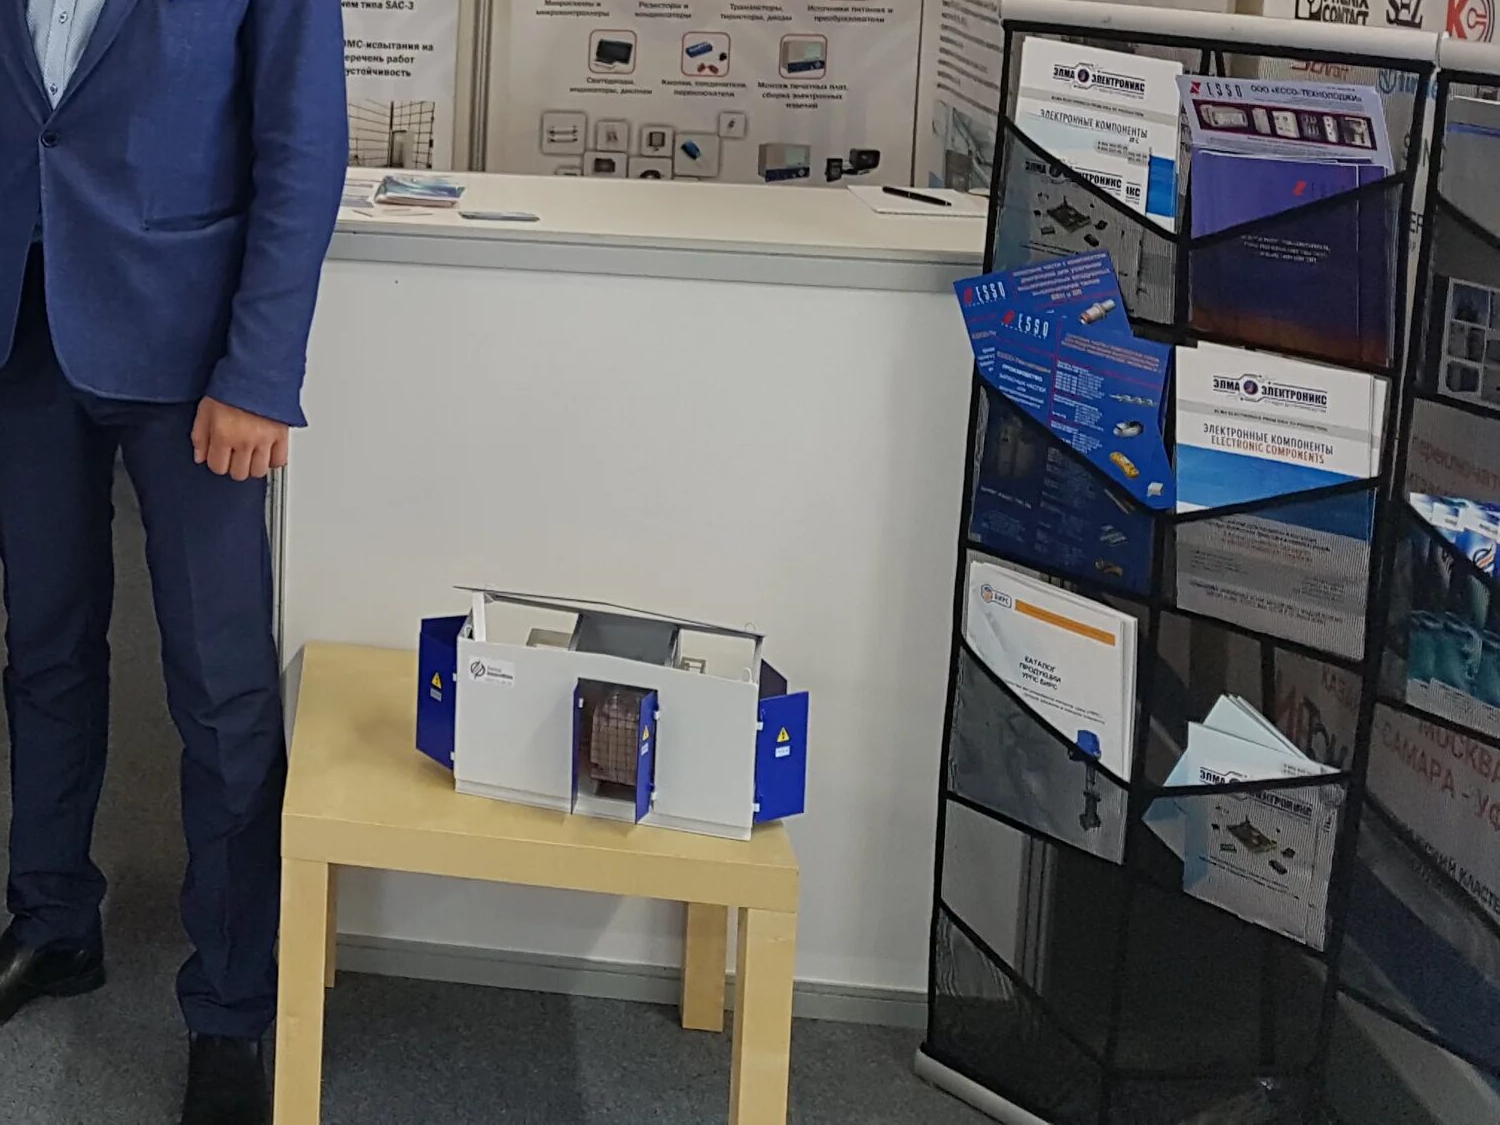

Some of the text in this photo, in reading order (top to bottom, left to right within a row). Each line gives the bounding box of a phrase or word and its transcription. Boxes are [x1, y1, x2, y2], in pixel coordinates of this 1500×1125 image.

[385, 0, 414, 10] SAC-3
[386, 55, 415, 65] работ
[1054, 67, 1145, 92] ЭЛМА ЭЛЕКТРОНИКС
[1251, 85, 1269, 93] ООО
[1040, 109, 1148, 138] ЭЛЕКТРОННЫЕ КОМПОНЕНТЫ
[1018, 313, 1049, 339] ESSO
[1213, 378, 1327, 405] ЭЛМА ЭЛЕКТРОНИКС
[1203, 423, 1333, 455] ЭЛЕКТРОННЫЕ КОМПОНЕНТЫ
[1211, 436, 1324, 464] ELECTRONIC COMPONENTS
